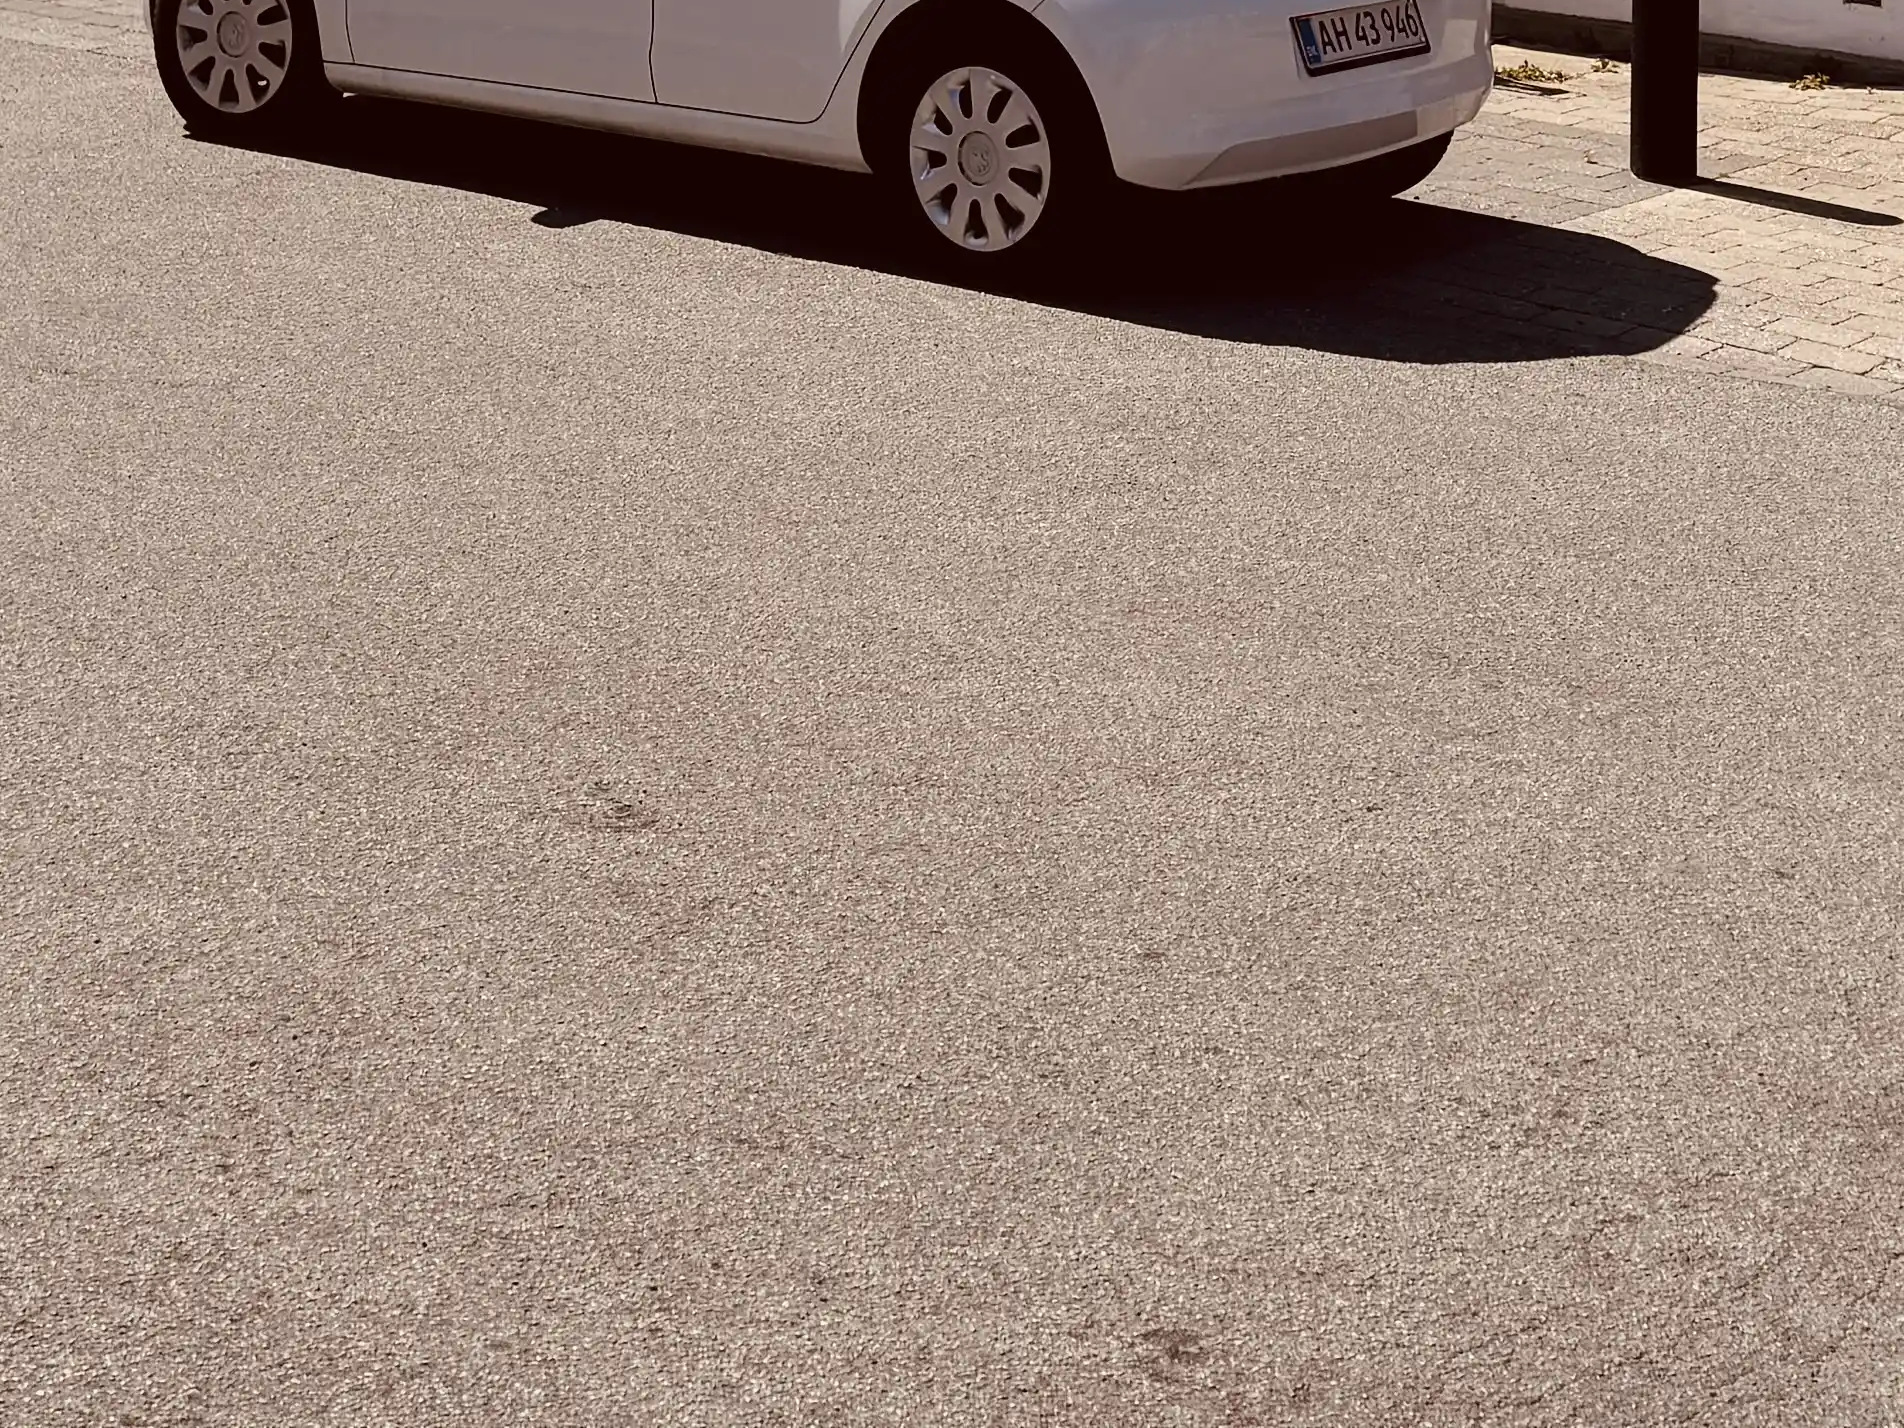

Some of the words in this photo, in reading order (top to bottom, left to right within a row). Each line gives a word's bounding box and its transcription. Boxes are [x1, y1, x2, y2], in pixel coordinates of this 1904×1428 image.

[1317, 19, 1353, 56] AH
[1354, 10, 1382, 47] 43
[1379, 0, 1421, 43] 946
